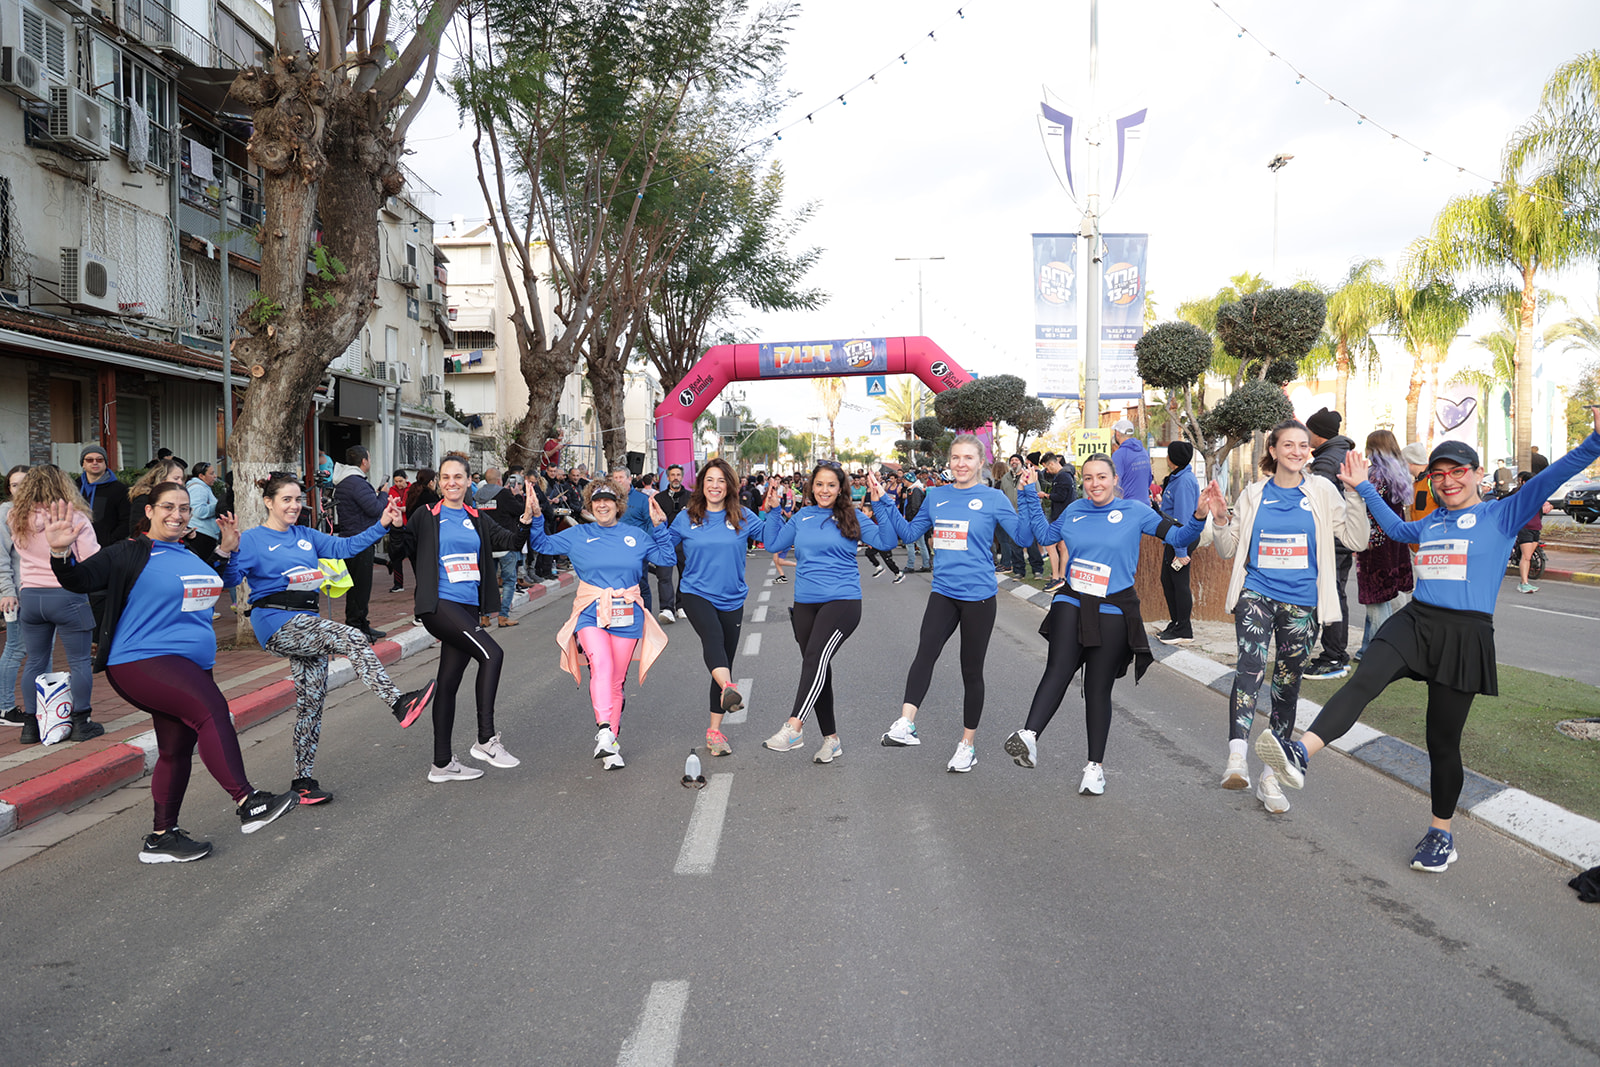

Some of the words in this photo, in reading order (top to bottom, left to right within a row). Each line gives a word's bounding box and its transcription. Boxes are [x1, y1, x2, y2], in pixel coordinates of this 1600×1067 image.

[774, 344, 833, 368] זינוק
[689, 374, 703, 391] Real
[948, 370, 963, 387] Real
[1078, 443, 1107, 456] זינוק
[1271, 547, 1293, 556] 1179
[1427, 555, 1449, 564] 1056
[1079, 572, 1095, 582] 1261
